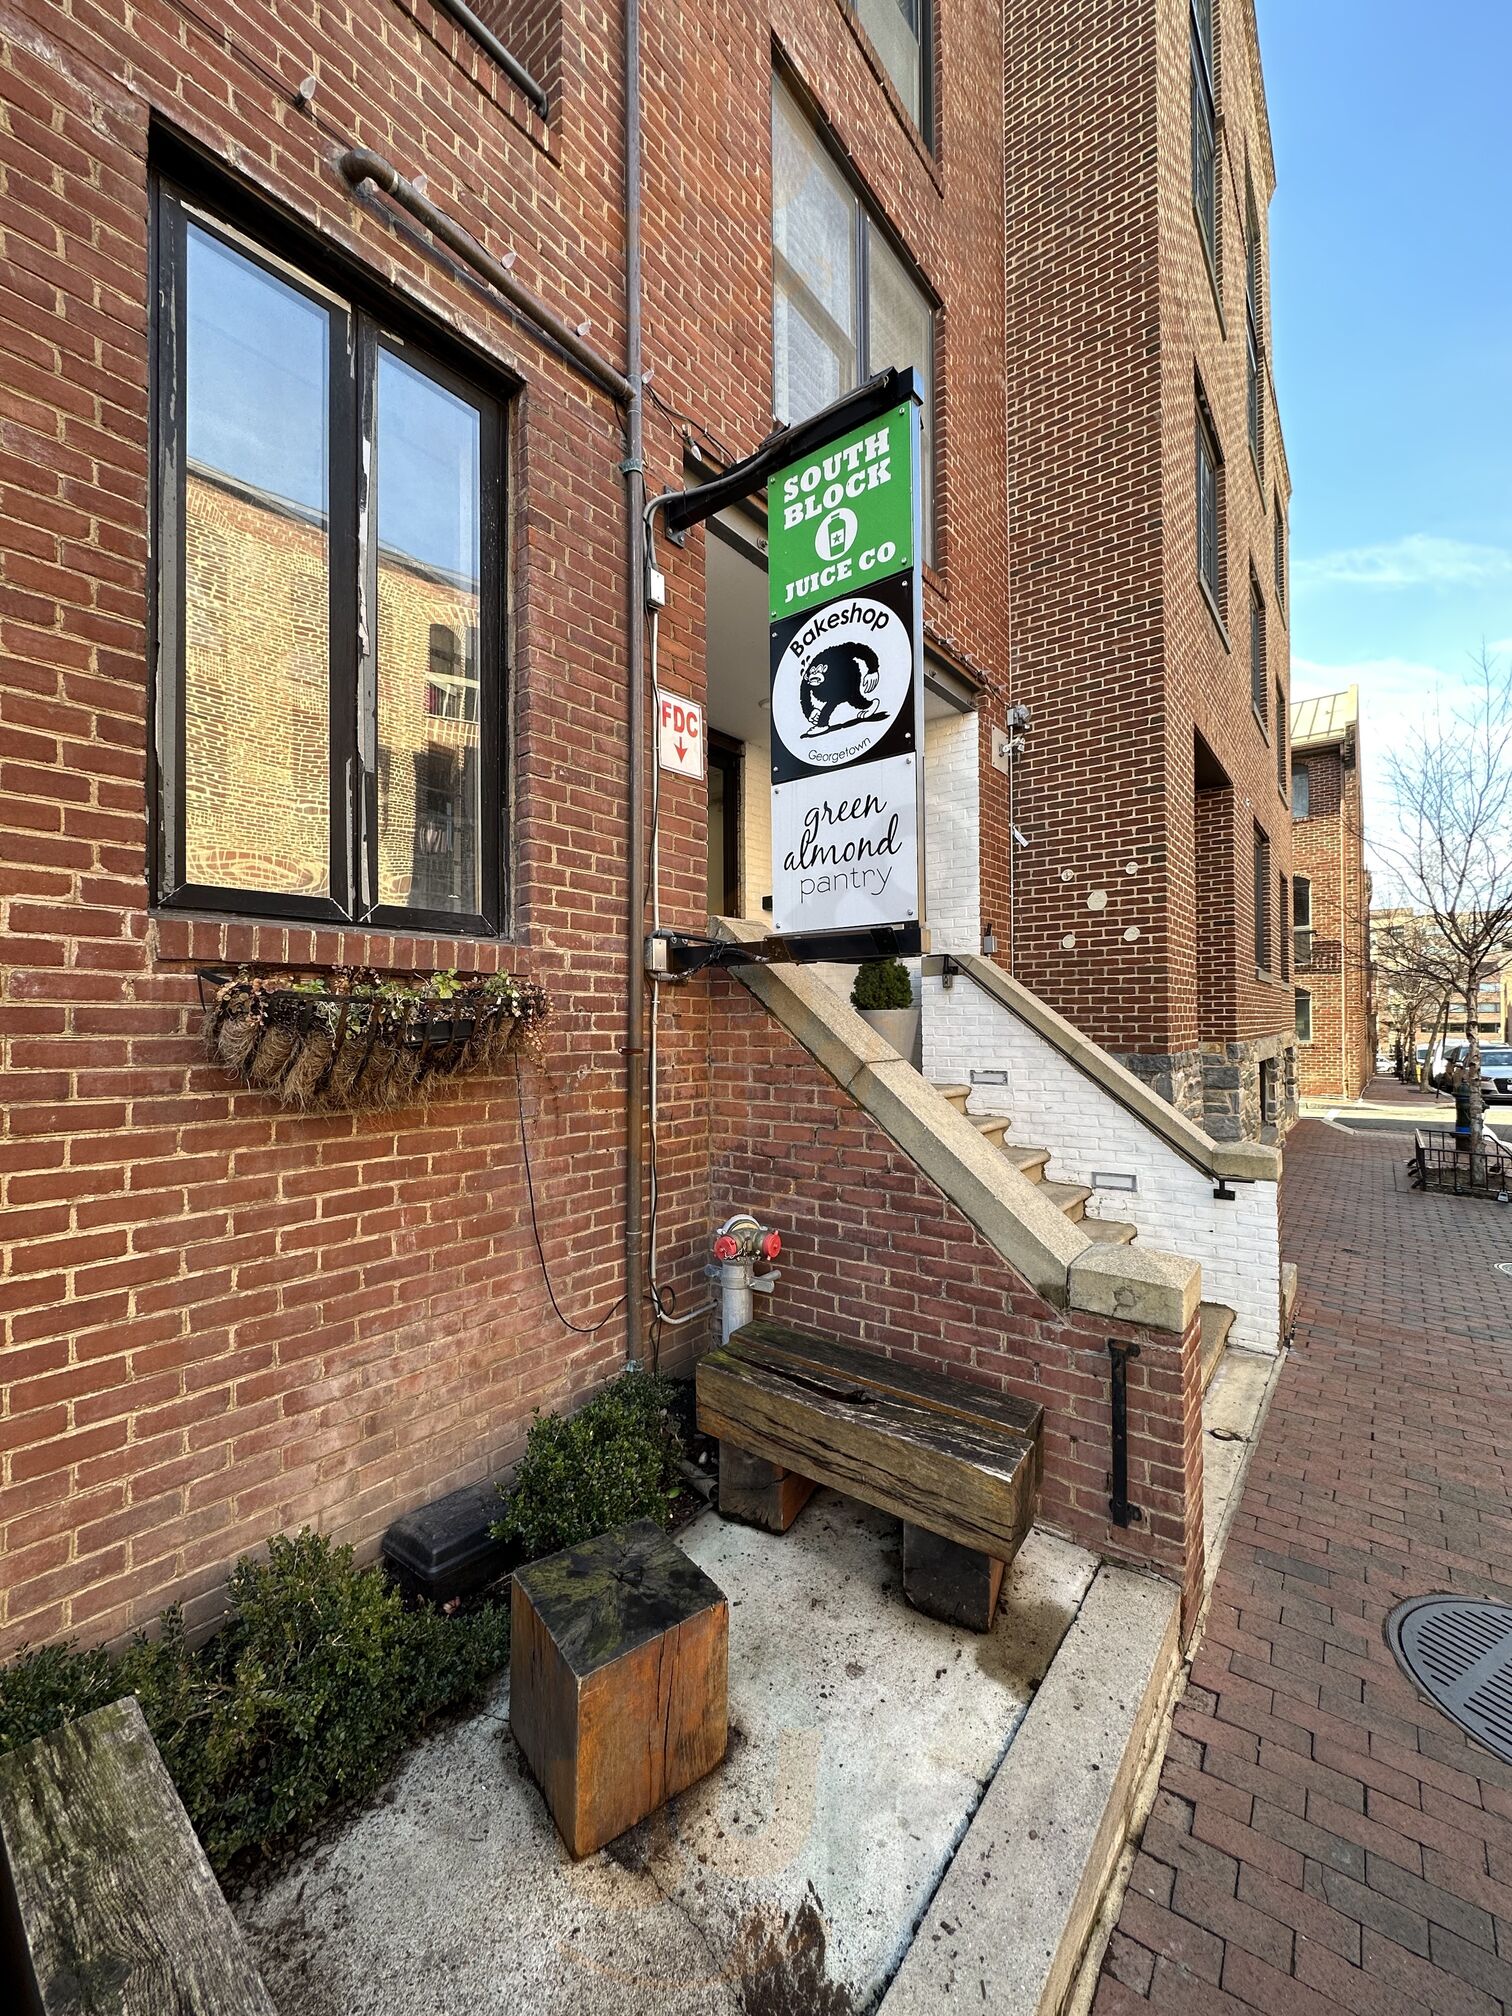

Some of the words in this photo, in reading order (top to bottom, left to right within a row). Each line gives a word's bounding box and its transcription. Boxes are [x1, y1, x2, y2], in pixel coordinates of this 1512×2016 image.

[784, 427, 890, 503] SOUTH
[784, 457, 891, 530] BLOCK
[785, 558, 852, 603] JUICE
[858, 541, 896, 571] CO
[790, 602, 890, 658] Bakeshop
[662, 700, 698, 737] FDC
[808, 736, 871, 763] Georgetown
[783, 813, 903, 871] almond
[804, 794, 887, 844] green
[800, 866, 893, 904] pantry
